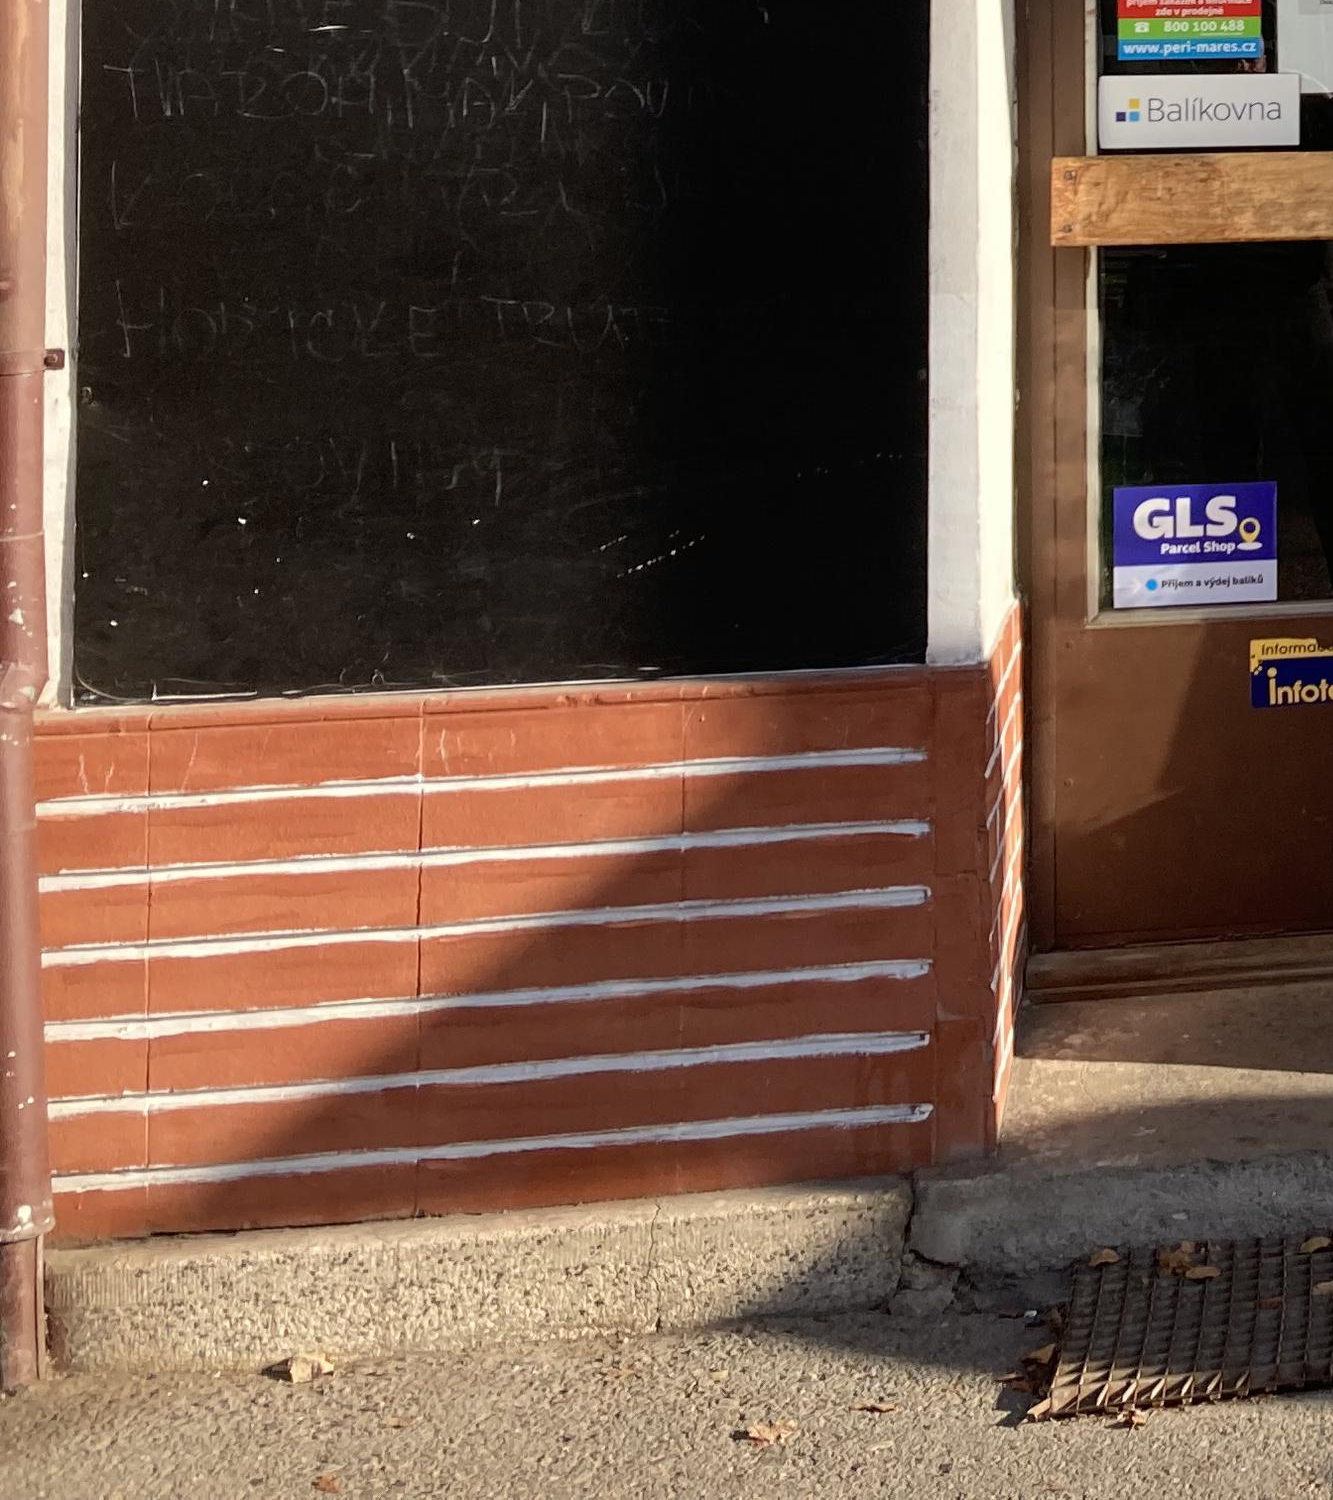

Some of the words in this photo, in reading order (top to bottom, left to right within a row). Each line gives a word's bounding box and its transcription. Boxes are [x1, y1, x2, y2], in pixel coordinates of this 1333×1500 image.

[1163, 21, 1189, 33] 800
[1193, 21, 1217, 32] 100
[1220, 20, 1245, 32] 488
[1123, 40, 1257, 56] www.peri-mares.cz
[1148, 97, 1281, 122] Balíkovna
[1133, 495, 1238, 540] GLS
[1160, 541, 1200, 555] Parcel
[1203, 540, 1236, 554] Shop
[1161, 578, 1194, 590] Příjem
[1204, 576, 1231, 588] výdej
[1232, 574, 1264, 585] balíků
